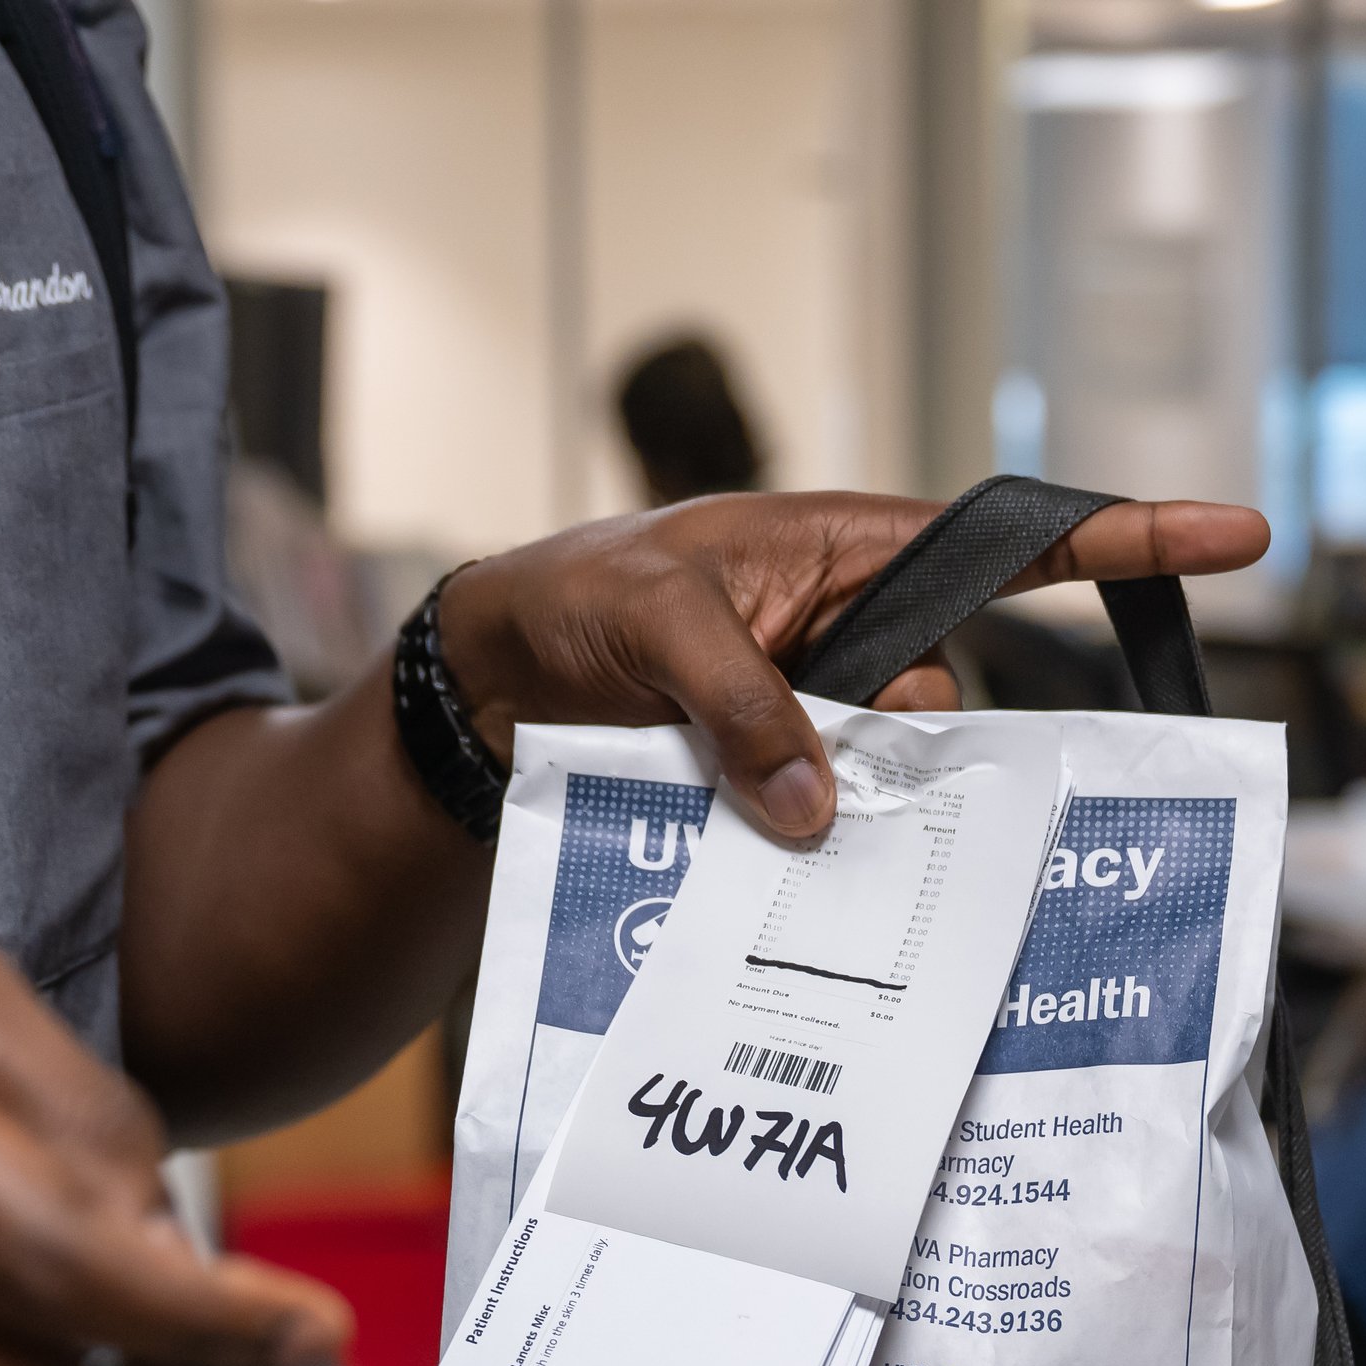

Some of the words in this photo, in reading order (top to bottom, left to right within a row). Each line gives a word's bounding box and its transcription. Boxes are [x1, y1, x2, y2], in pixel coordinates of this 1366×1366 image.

[923, 824, 956, 835] Amount
[934, 836, 955, 846] $0.00
[930, 849, 951, 859] $0.00
[926, 863, 948, 872] $0.00
[1044, 847, 1165, 901] acy
[922, 876, 944, 886] $0.00
[919, 889, 940, 898] $0.00
[915, 902, 936, 911] $0.00
[911, 915, 932, 924] $0.00
[907, 927, 928, 936] $0.00
[903, 938, 924, 947] $0.00
[898, 950, 920, 959] $0.00
[894, 961, 915, 970] $0.00
[745, 965, 766, 974] Total
[878, 993, 902, 1004] $0.00
[889, 972, 911, 981] $0.00
[736, 982, 770, 994] Amount
[772, 989, 790, 998] Due
[997, 975, 1151, 1029] Health
[728, 999, 740, 1007] No
[742, 1002, 780, 1015] payment
[782, 1011, 798, 1019] was
[800, 1014, 841, 1029] collected.
[870, 1011, 894, 1021] $0.00
[959, 1118, 1046, 1143] Student
[1052, 1112, 1123, 1137] Health
[938, 1153, 1015, 1178] armacy
[929, 1178, 1071, 1207] 4.924.1544
[590, 1237, 610, 1262] daily.
[914, 1236, 941, 1262] VA
[948, 1243, 1059, 1270] Pharmacy
[465, 1296, 500, 1345] Patient
[490, 1217, 539, 1296] Instructions
[575, 1263, 595, 1290] times
[570, 1290, 581, 1299] 3
[948, 1275, 1071, 1302] Crossroads
[531, 1303, 552, 1330] Misc
[562, 1299, 577, 1320] skin
[889, 1297, 1063, 1334] 434.243.9136
[553, 1319, 567, 1338] the
[543, 1337, 558, 1359] into
